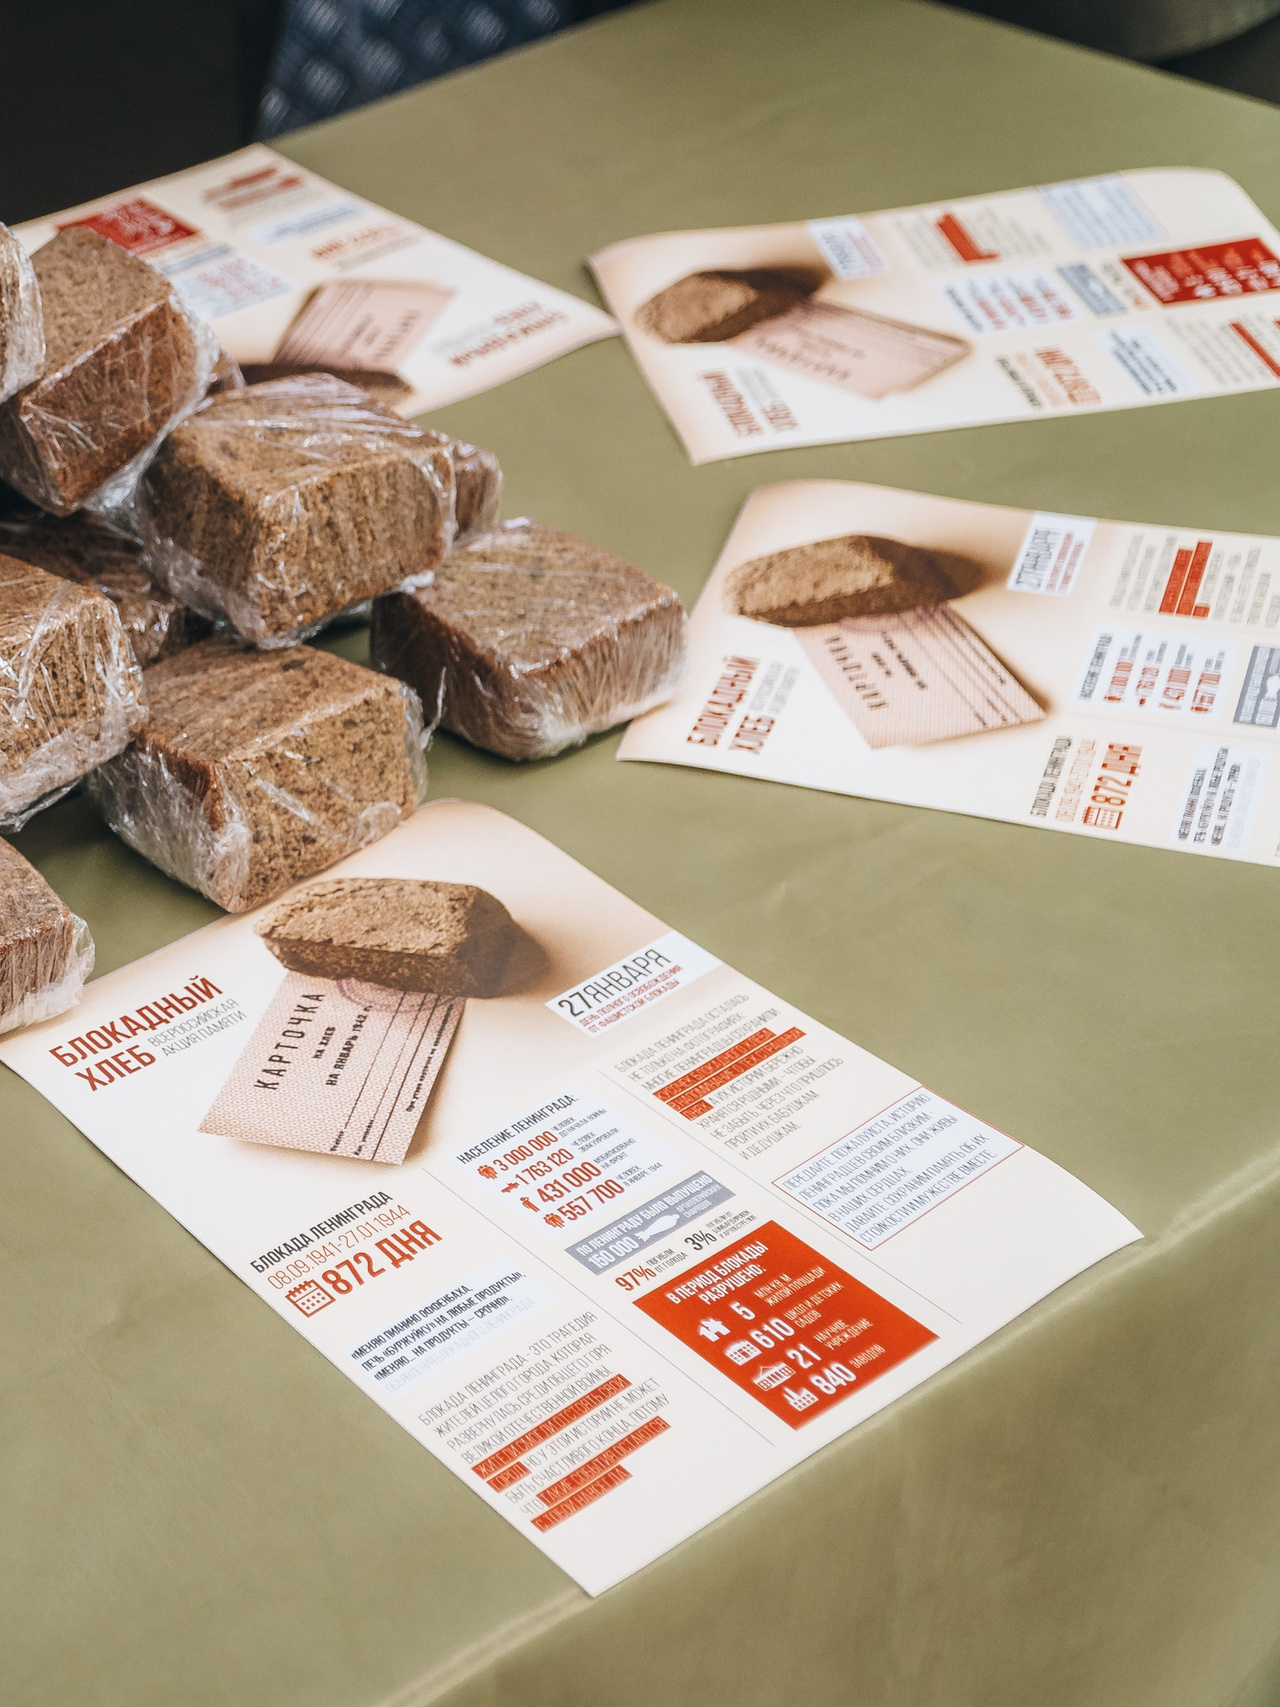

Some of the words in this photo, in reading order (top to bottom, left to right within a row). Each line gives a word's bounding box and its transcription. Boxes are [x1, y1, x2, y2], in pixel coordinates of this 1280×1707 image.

[1091, 775, 1132, 806] 872
[48, 977, 223, 1067] БЛОКАДНЫЙ
[147, 997, 239, 1047] ВСЕРОССИЙСКАЯ
[159, 1032, 203, 1057] АКЦИЯ
[196, 1010, 248, 1038] ПАМЯТИ
[253, 995, 326, 1089] КАРТОЧКА
[74, 1044, 158, 1091] ХЛЕБ
[326, 1073, 339, 1085] НА
[334, 1034, 358, 1069] ЯНВАРЬ
[352, 1014, 368, 1031] 1942
[456, 1128, 516, 1164] НАСЕЛЕНИЕ
[509, 1092, 579, 1134] ЛЕНИНГРАДА:
[491, 1158, 510, 1171] 3
[501, 1144, 535, 1165] 000
[526, 1129, 560, 1151] 000
[520, 1159, 554, 1181] 763
[544, 1147, 575, 1167] 120
[513, 1173, 530, 1185] 1
[532, 1178, 572, 1205] 431
[560, 1160, 604, 1188] 000
[841, 1200, 891, 1232] ДАВАЙТЕ
[881, 1170, 934, 1206] СОХРАНИМ
[924, 1148, 968, 1176] ПАМЯТЬ
[556, 1194, 597, 1222] 557
[585, 1177, 627, 1205] 700
[576, 1243, 594, 1256] ПО
[587, 1214, 647, 1249] ЛЕНИНГРАДУ
[639, 1200, 669, 1220] БЫЛО
[663, 1174, 715, 1207] ВЫПУЩЕНО
[249, 1231, 316, 1274] БЛОКАДА
[307, 1190, 394, 1239] ЛЕНИНГРАДА
[265, 1203, 413, 1290] 08.09.1941-27.01.1944
[587, 1249, 617, 1269] 150
[607, 1235, 640, 1257] 000
[682, 1228, 718, 1252] 3%
[318, 1249, 387, 1296] 872
[374, 1219, 443, 1268] ДНЯ
[646, 1247, 675, 1266] ПОГИБЛИ
[654, 1264, 666, 1273] ОТ
[662, 1251, 689, 1268] ГОЛОДА
[712, 1239, 771, 1278] БЛОКАДЫ
[613, 1262, 658, 1292] 97%
[673, 1268, 722, 1300] ПЕРИОД
[698, 1261, 767, 1305] РАЗРУШЕНО:
[753, 1283, 775, 1299] МЛН
[778, 1272, 793, 1282] М
[762, 1286, 794, 1306] ЖИЛОЙ
[787, 1265, 828, 1292] ПЛОЩАДИ
[665, 1292, 682, 1304] В
[728, 1300, 757, 1321] 5
[783, 1303, 809, 1321] ШКОЛ
[808, 1280, 846, 1305] ДЕТСКИХ
[348, 1334, 388, 1360] «МЕНЯЮ
[382, 1313, 423, 1339] ПИАНИНО
[417, 1283, 474, 1319] ОФФЕНБАХА,
[360, 1353, 386, 1371] ПЕЧЬ
[379, 1319, 438, 1358] «БУРЖУЙКУ»
[433, 1314, 450, 1326] НА
[444, 1296, 478, 1319] ЛЮБЫЕ
[473, 1268, 526, 1302] ПРОДУКТЫ»,
[411, 1344, 428, 1356] НА
[422, 1319, 471, 1350] ПРОДУКТЫ
[747, 1315, 797, 1350] 610
[793, 1309, 823, 1329] САДОВ
[813, 1319, 849, 1343] НАУЧНОЕ
[823, 1318, 875, 1351] УЧРЕЖДЕНИЕ
[417, 1390, 470, 1425] БЛОКАДА
[463, 1353, 529, 1396] ЛЕНИНГРАДА
[527, 1338, 553, 1356] ЭТО
[546, 1310, 599, 1345] ТРАГЕДИЯ
[783, 1342, 823, 1369] 21
[848, 1343, 887, 1369] ЗАВОДОВ
[430, 1402, 483, 1438] ЖИТЕЛЕЙ
[475, 1380, 520, 1410] ЦЕЛОГО
[549, 1332, 597, 1363] КОТОРАЯ
[807, 1360, 860, 1396] 840
